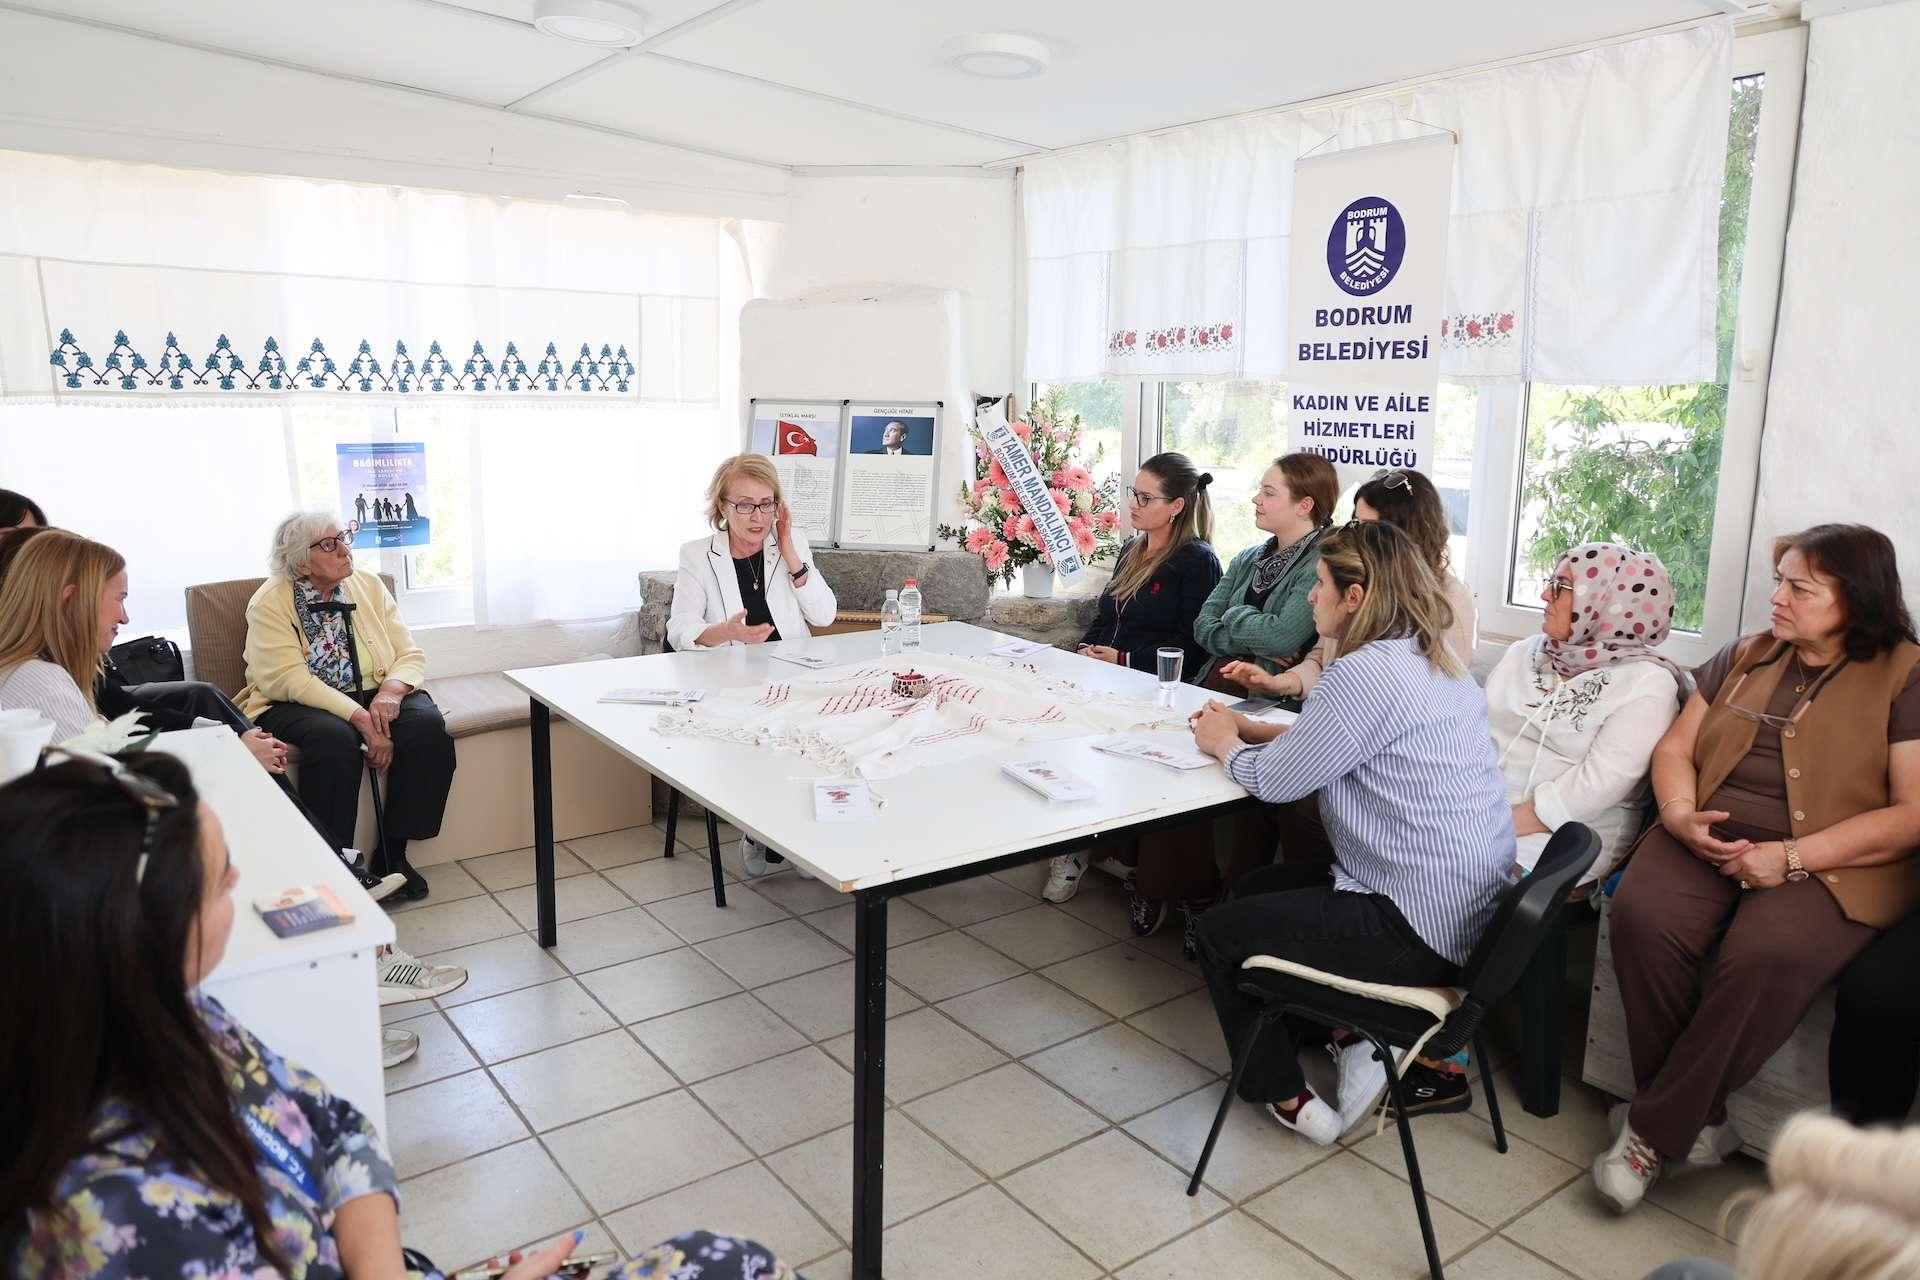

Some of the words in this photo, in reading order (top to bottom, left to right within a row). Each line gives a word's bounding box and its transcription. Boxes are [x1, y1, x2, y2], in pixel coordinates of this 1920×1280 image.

[1347, 206, 1388, 220] BODRUM
[1340, 267, 1390, 290] BELEDİYESİ
[1315, 304, 1413, 328] BODRUM
[1298, 334, 1429, 361] BELEDİYESİ
[1293, 394, 1349, 411] KADIN
[1354, 395, 1380, 411] VE
[1384, 391, 1430, 412] AİLE
[1303, 417, 1415, 440] HİZMETLERİ
[994, 447, 1017, 482] BODRUM
[1001, 436, 1032, 479] TAMER
[1022, 475, 1074, 554] MANDALİNCİ
